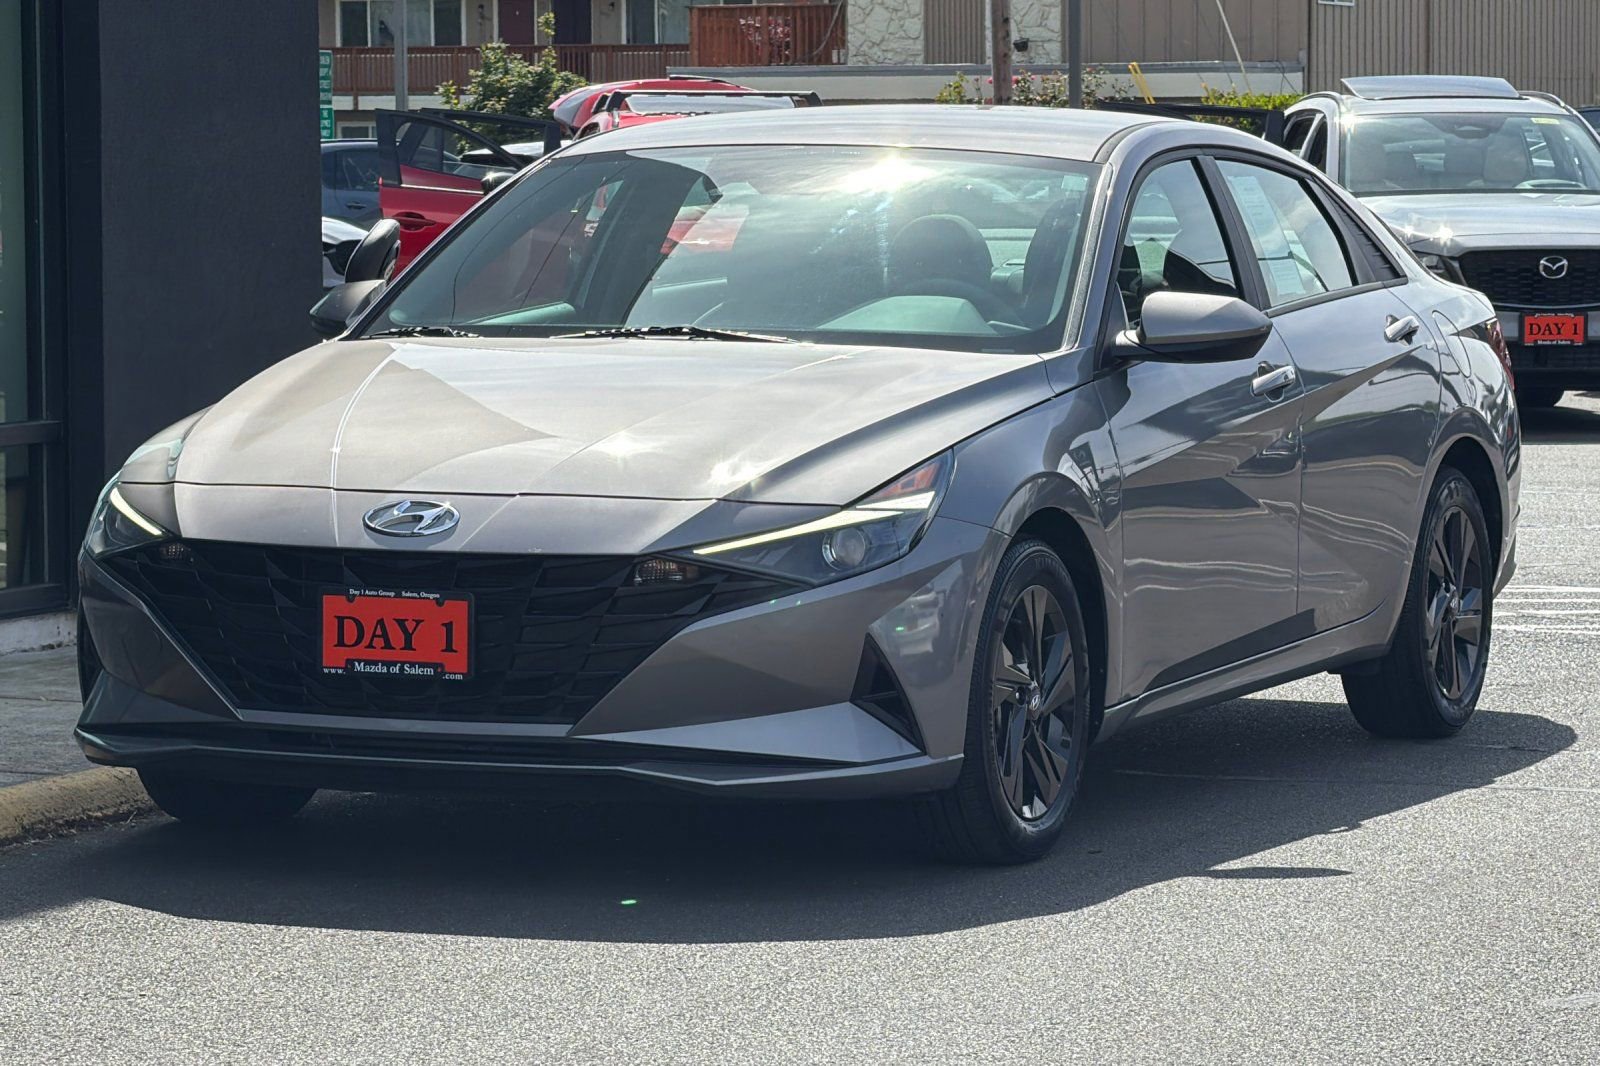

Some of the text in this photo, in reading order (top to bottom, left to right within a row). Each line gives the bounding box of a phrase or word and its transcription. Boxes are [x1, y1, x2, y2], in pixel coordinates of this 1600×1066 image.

[1529, 323, 1578, 335] DAY 1
[378, 590, 395, 598] Group
[334, 615, 458, 653] DAY 1
[353, 661, 387, 673] Mazda
[390, 664, 401, 673] of
[404, 664, 434, 675] Salem
